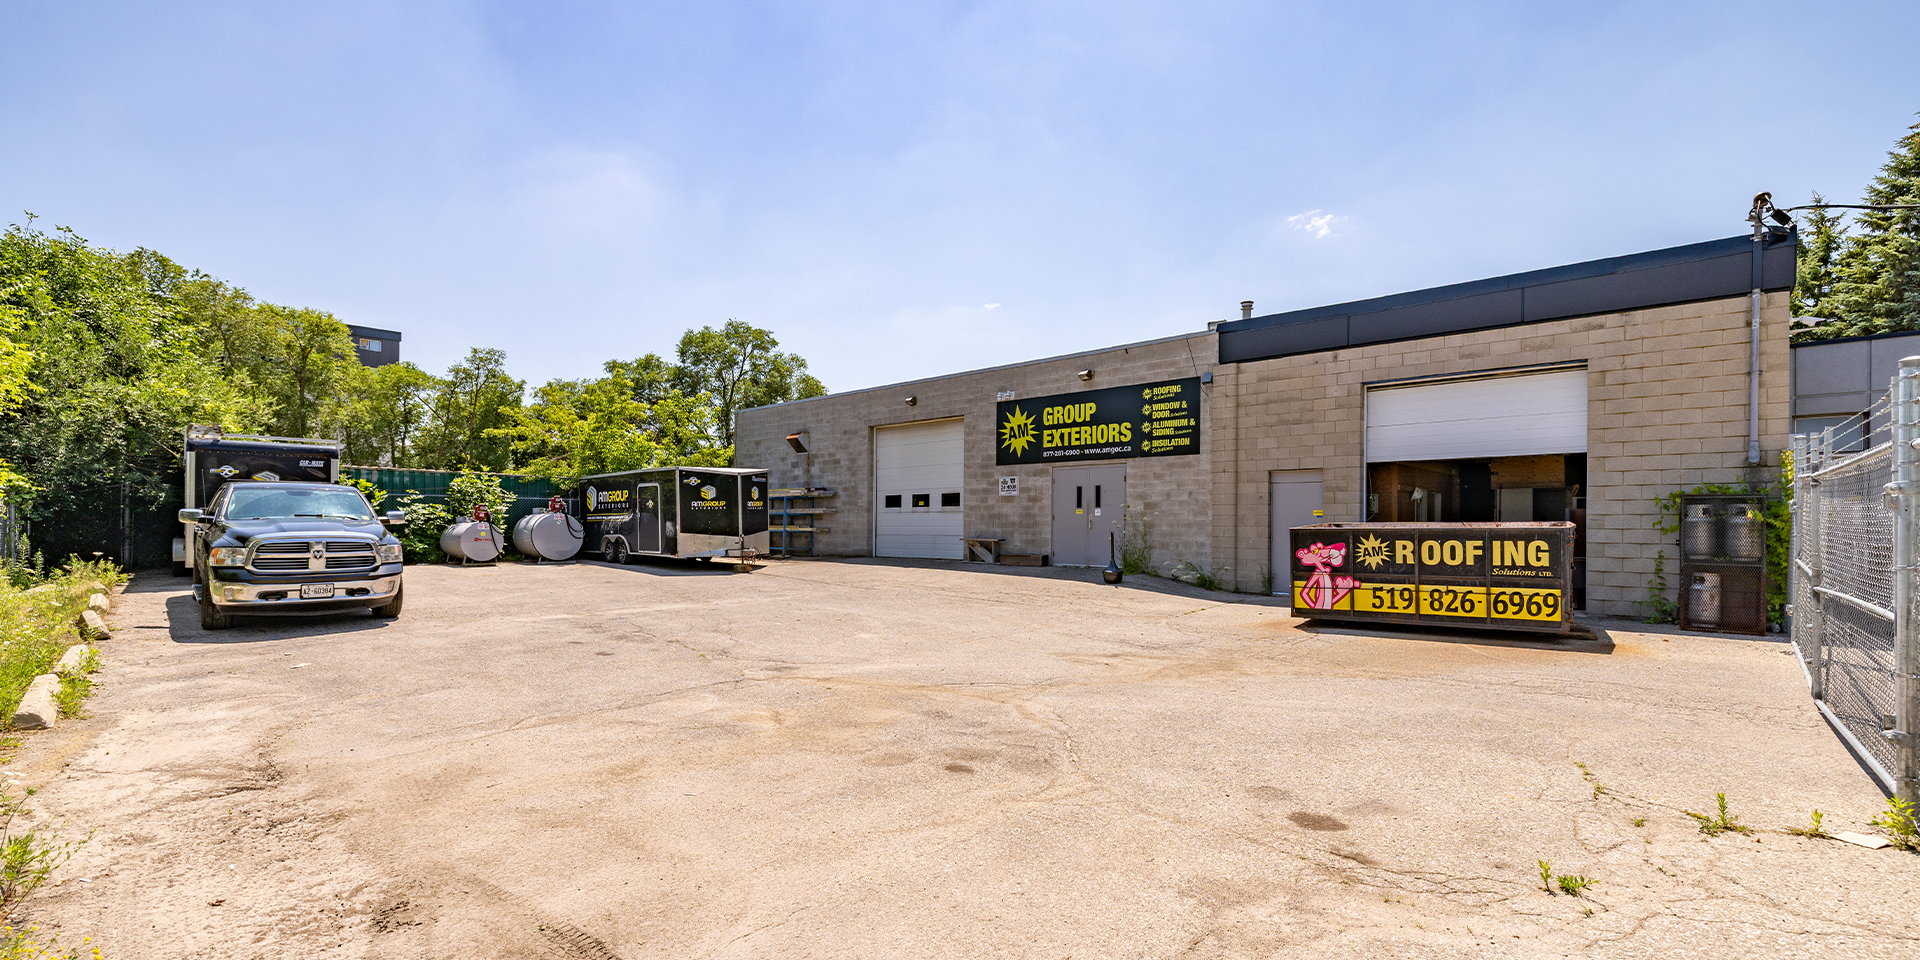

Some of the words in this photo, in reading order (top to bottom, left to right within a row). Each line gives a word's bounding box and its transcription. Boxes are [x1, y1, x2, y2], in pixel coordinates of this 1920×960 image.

[1153, 385, 1181, 395] ROOFING
[1152, 401, 1180, 410] WINDOW
[1043, 402, 1096, 425] GROUP
[1152, 410, 1170, 419] DOOR
[1152, 419, 1188, 428] ALUMINUM
[1008, 423, 1029, 442] AM
[1043, 422, 1132, 448] EXTERIORS
[1152, 428, 1174, 436] SIDING
[1152, 438, 1190, 447] INSULATION
[1084, 446, 1131, 455] www.amgoc.ca
[1363, 545, 1383, 558] AM
[1395, 540, 1549, 567] ROOFING
[1492, 568, 1536, 576] Solutions
